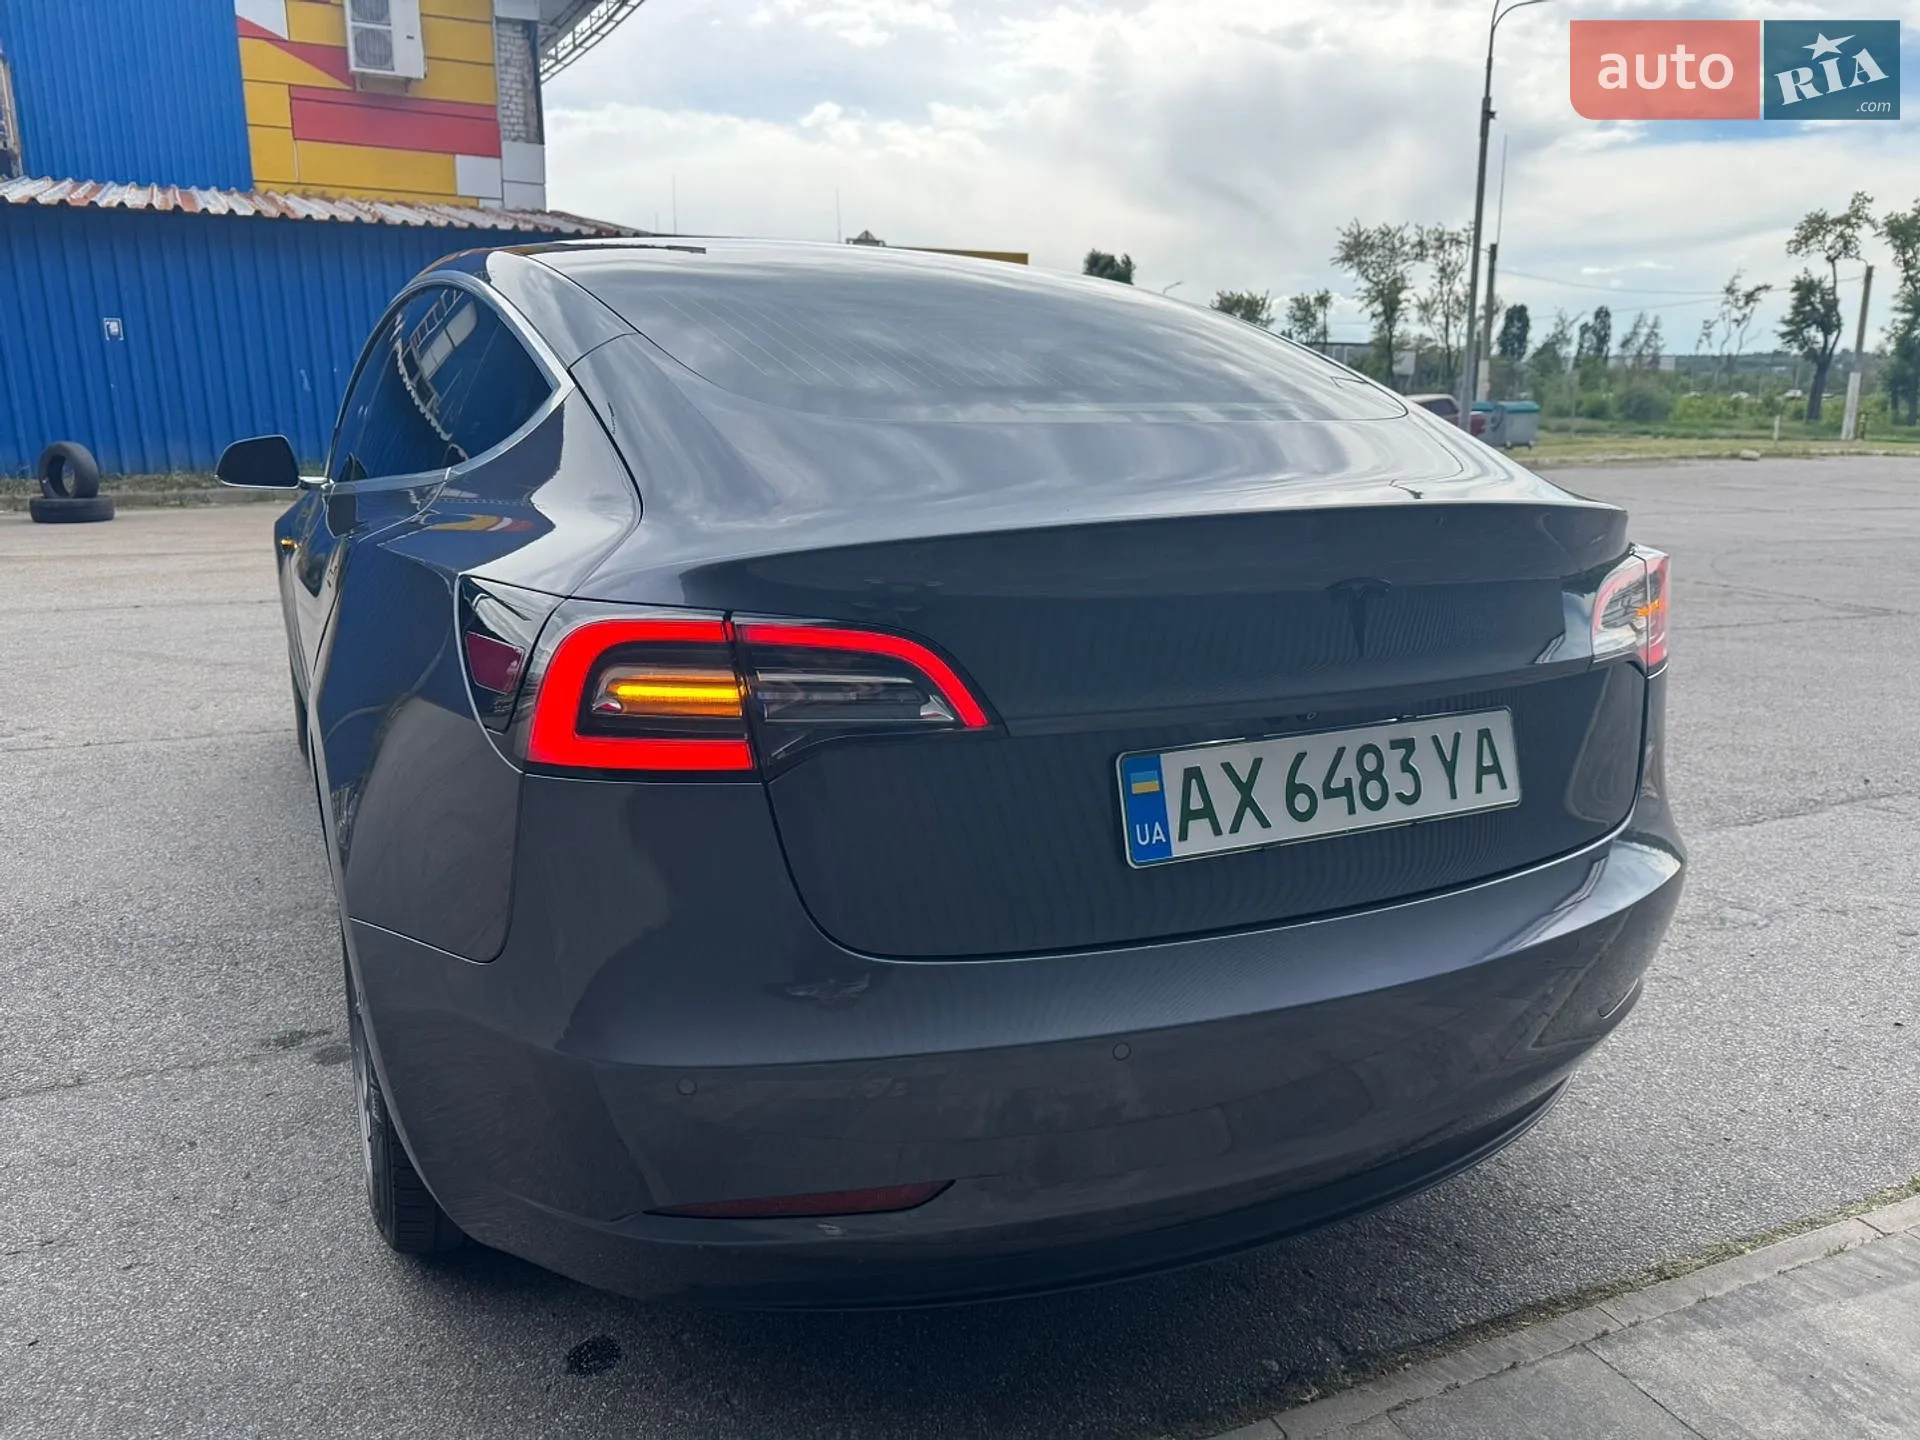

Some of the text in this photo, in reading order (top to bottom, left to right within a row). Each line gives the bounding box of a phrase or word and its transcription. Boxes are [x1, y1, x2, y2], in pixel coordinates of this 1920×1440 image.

[1178, 728, 1508, 842] AX 6483 YA
[1136, 821, 1166, 846] UA
